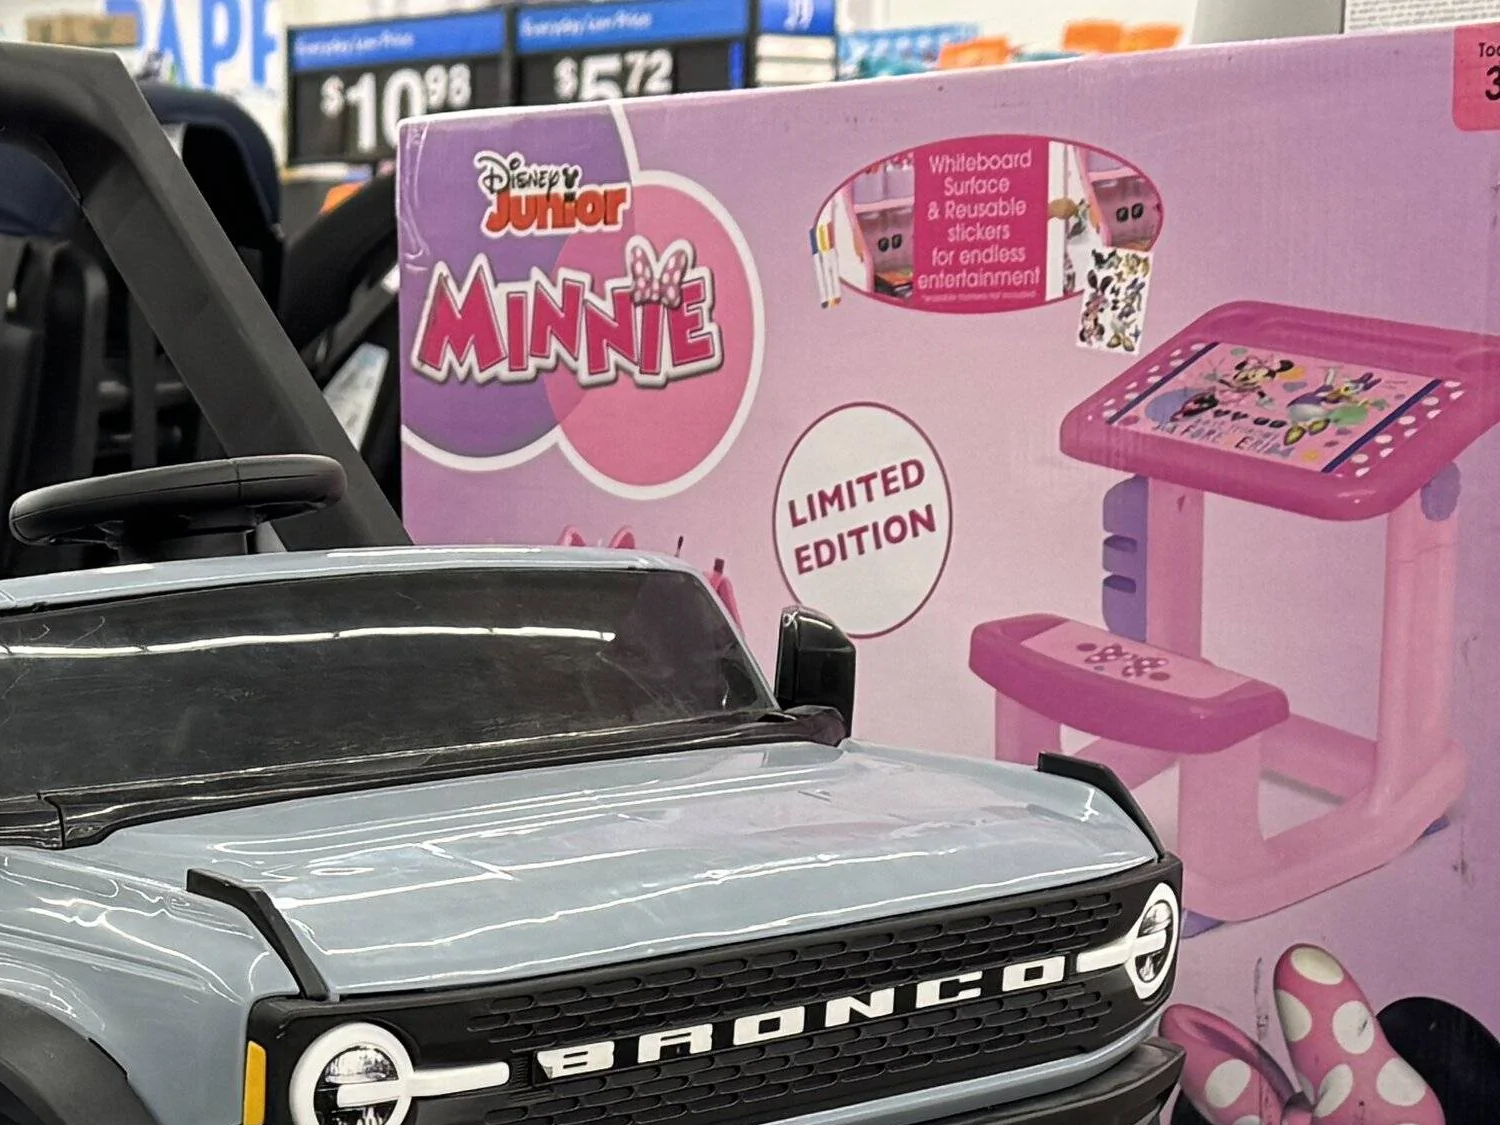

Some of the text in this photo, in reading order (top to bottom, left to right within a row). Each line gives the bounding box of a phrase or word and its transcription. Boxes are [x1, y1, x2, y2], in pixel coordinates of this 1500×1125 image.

[928, 149, 1032, 174] Whiteboard
[944, 176, 1010, 196] Surface
[928, 197, 1027, 221] & Reusable
[948, 223, 1010, 242] stickers
[932, 245, 1026, 266] for endless
[918, 267, 1040, 289] entertainment
[415, 262, 718, 380] MINNIE
[788, 458, 925, 528] LIMITED
[794, 503, 936, 575] EDITION
[536, 955, 1066, 1079] BRONCO
